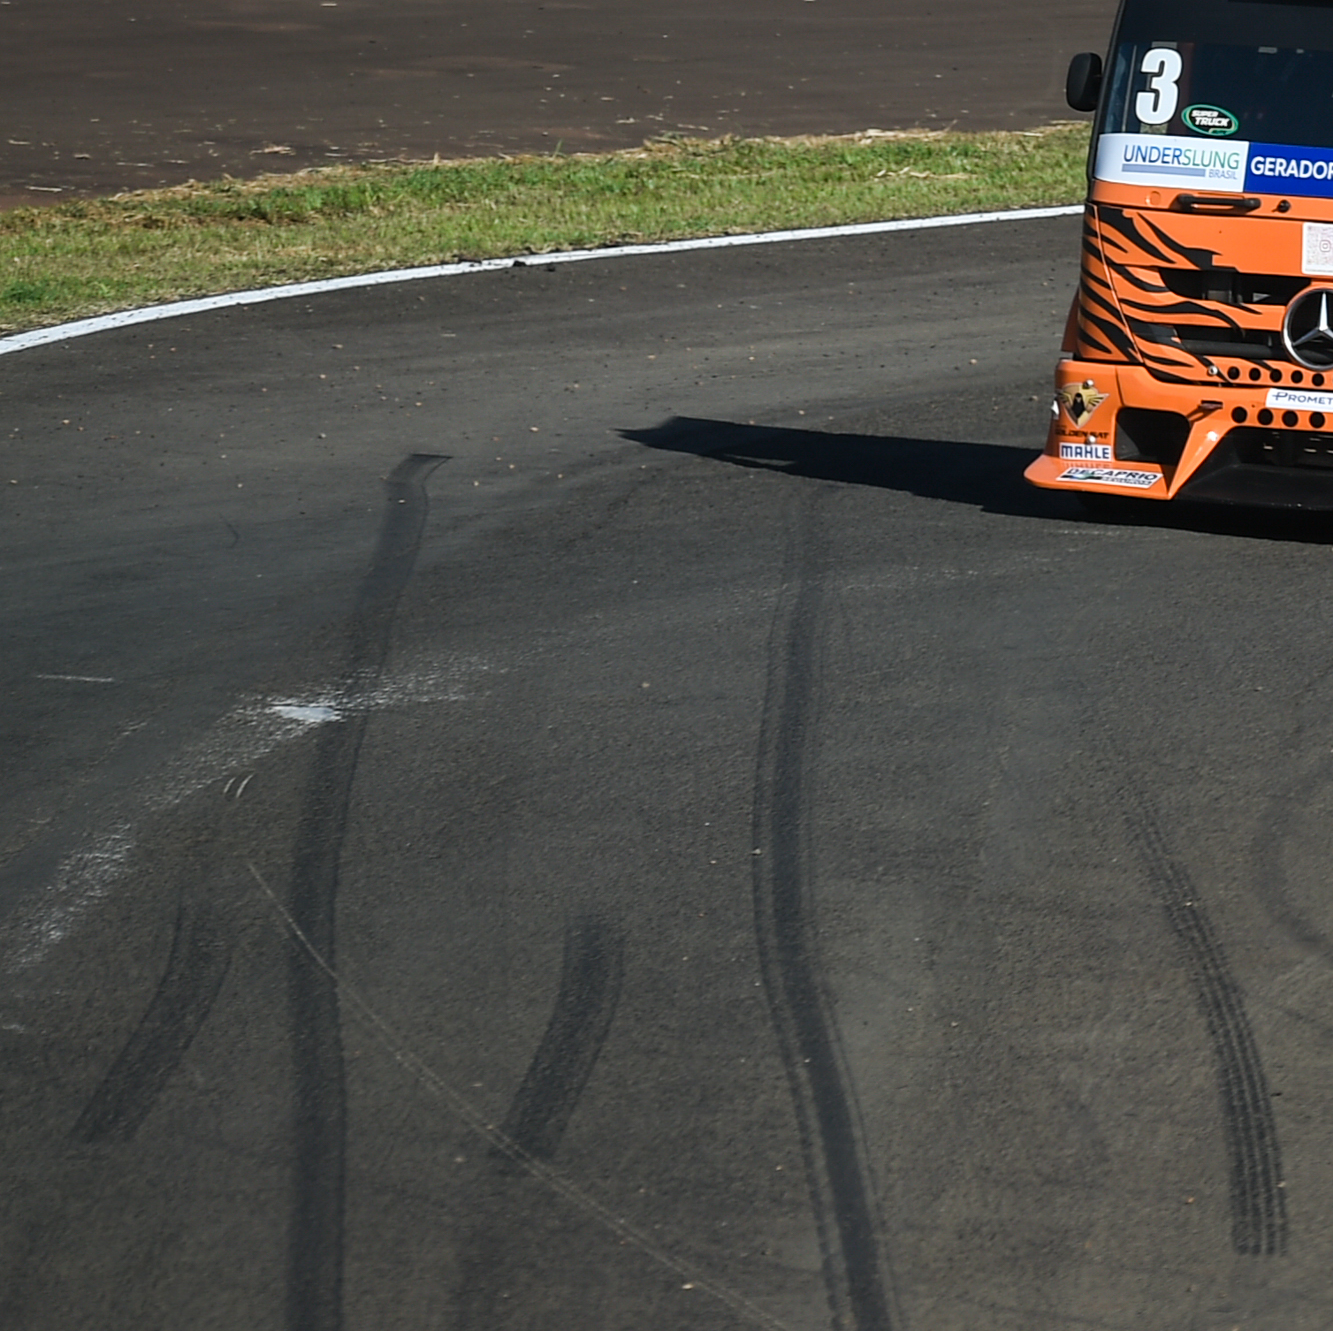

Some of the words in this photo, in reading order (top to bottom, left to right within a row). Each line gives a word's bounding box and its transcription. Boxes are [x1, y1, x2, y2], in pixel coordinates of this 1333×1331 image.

[1135, 47, 1182, 125] 3
[1191, 109, 1219, 118] SUPER
[1194, 116, 1231, 128] TRUCK
[1123, 144, 1240, 170] UNDERSLUNG
[1208, 168, 1238, 180] BRASIL
[1060, 444, 1110, 460] MAHLE
[1066, 467, 1158, 481] DECAPRIO
